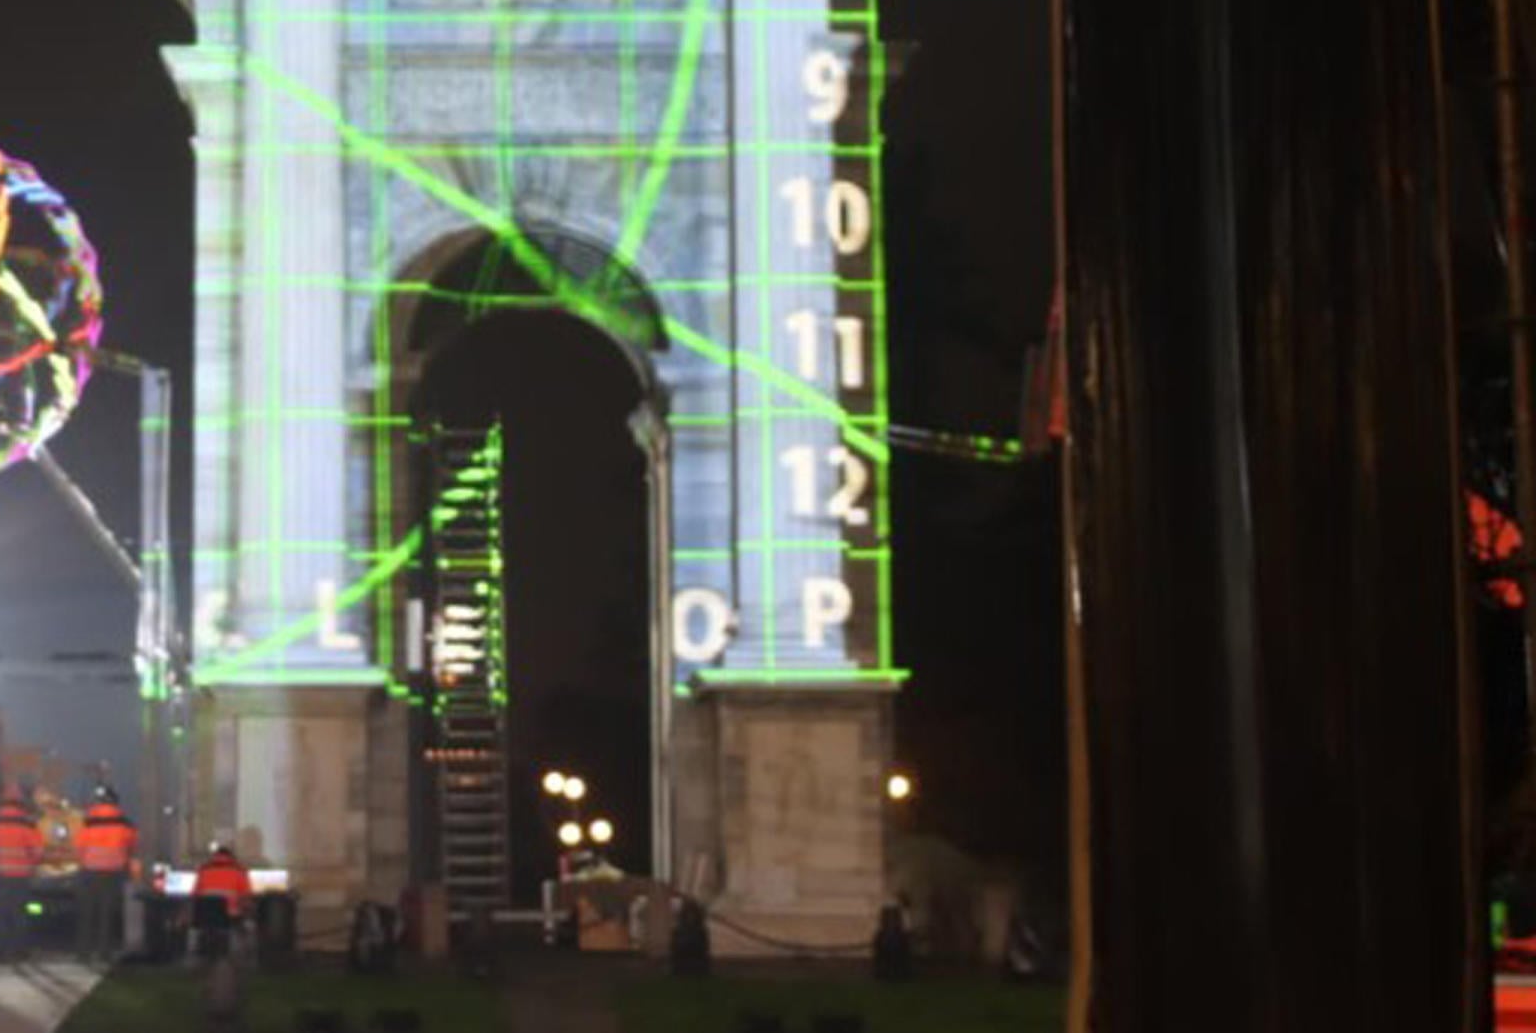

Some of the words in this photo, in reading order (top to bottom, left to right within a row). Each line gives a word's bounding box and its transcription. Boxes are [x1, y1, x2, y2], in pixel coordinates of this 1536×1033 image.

[801, 49, 852, 126] 9
[778, 174, 873, 255] 10
[785, 309, 866, 390] 11
[778, 443, 872, 526] 12
[670, 586, 740, 665] O
[800, 576, 855, 649] P
